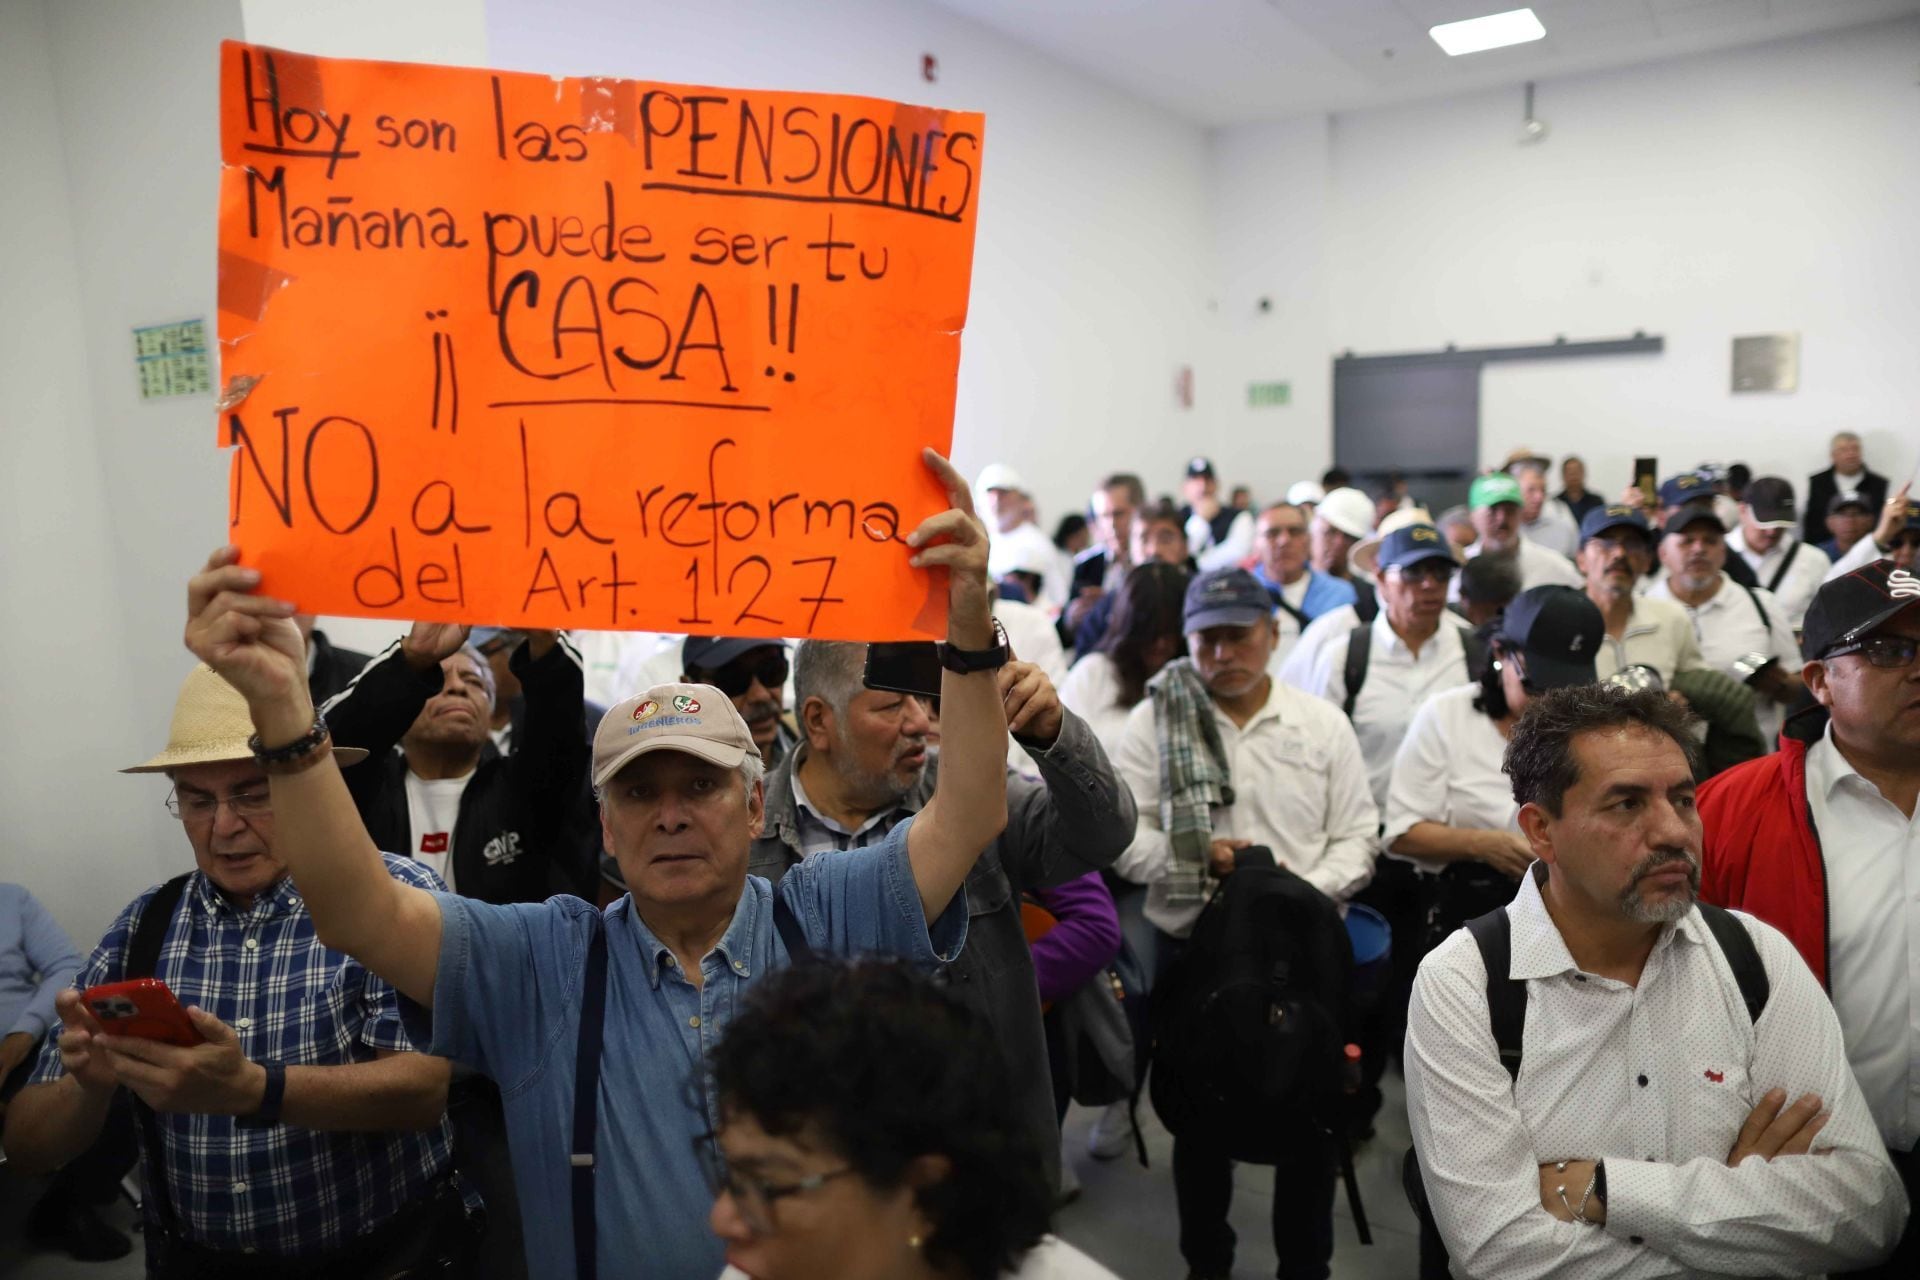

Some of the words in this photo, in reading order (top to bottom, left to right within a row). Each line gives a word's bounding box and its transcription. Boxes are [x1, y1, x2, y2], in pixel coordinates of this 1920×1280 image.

[243, 48, 351, 179] Hoy
[376, 116, 457, 152] son
[491, 75, 590, 163] las
[639, 89, 979, 217] PENSIONES
[246, 166, 469, 250] Mañana
[484, 181, 666, 315] puede
[690, 235, 789, 267] ser
[807, 212, 889, 282] tu
[499, 269, 739, 392] CASA
[230, 406, 380, 535] NO
[411, 480, 491, 534] a
[519, 418, 615, 548] la
[635, 438, 908, 597] reforma
[353, 526, 465, 608] del
[521, 547, 639, 624] Art.
[680, 555, 845, 634] 127
